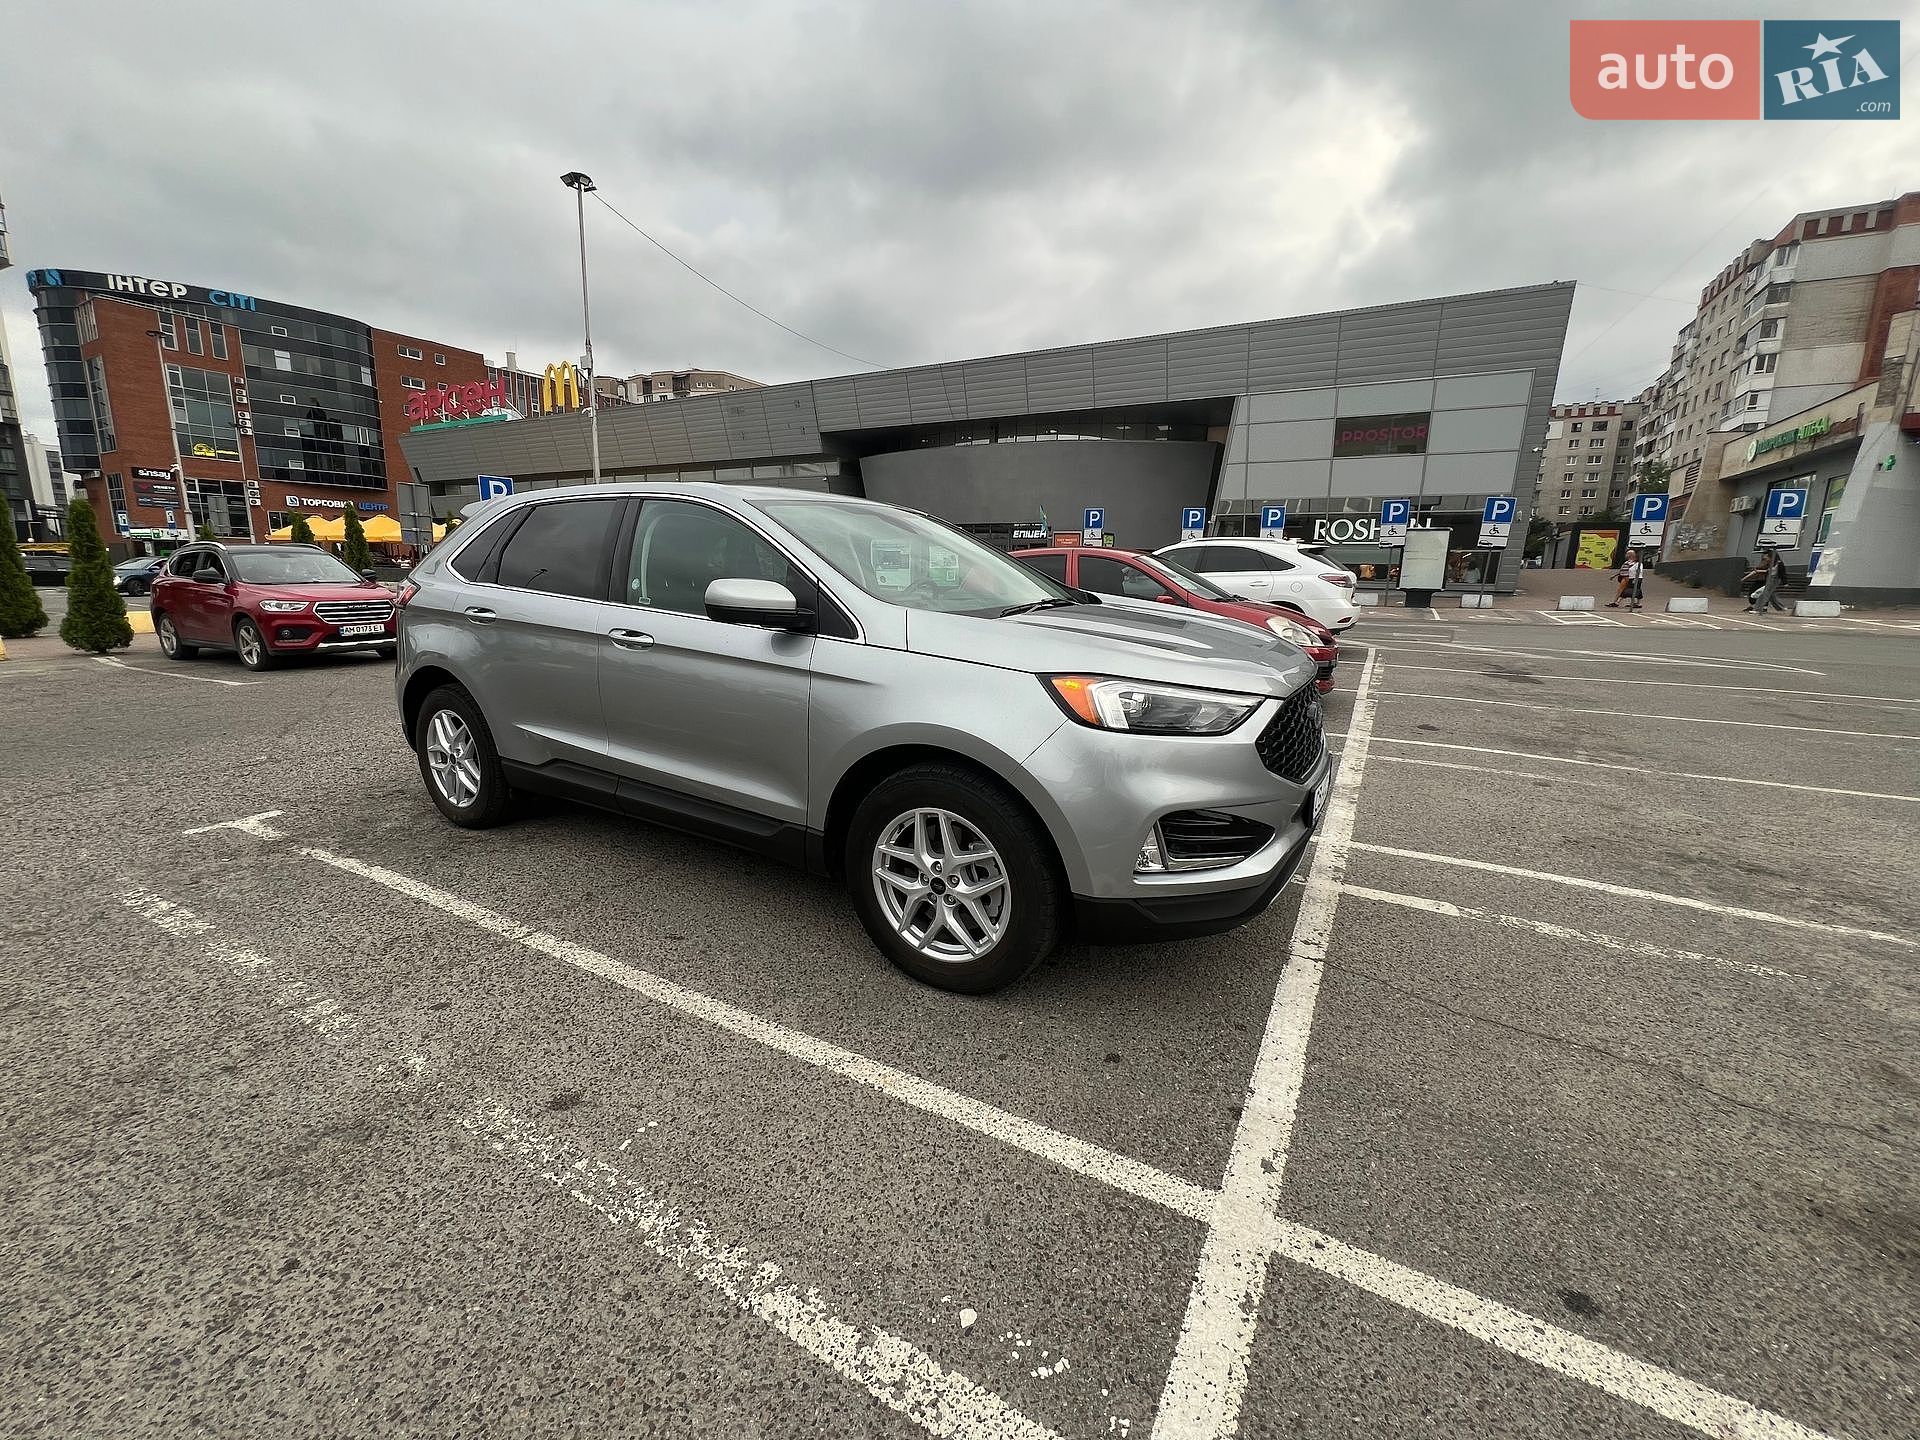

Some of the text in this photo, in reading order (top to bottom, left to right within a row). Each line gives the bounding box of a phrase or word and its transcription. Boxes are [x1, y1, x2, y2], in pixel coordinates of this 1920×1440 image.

[1342, 425, 1428, 442] PROSTOR
[138, 468, 171, 480] sinsay
[301, 498, 389, 511] ТОРГОВИ ЦЕНТР
[1388, 503, 1404, 522] P
[1491, 500, 1510, 520] P
[1642, 498, 1662, 519] P
[1776, 492, 1799, 516] P
[1089, 511, 1100, 527] P
[1188, 510, 1201, 527] P
[1267, 509, 1281, 527] P
